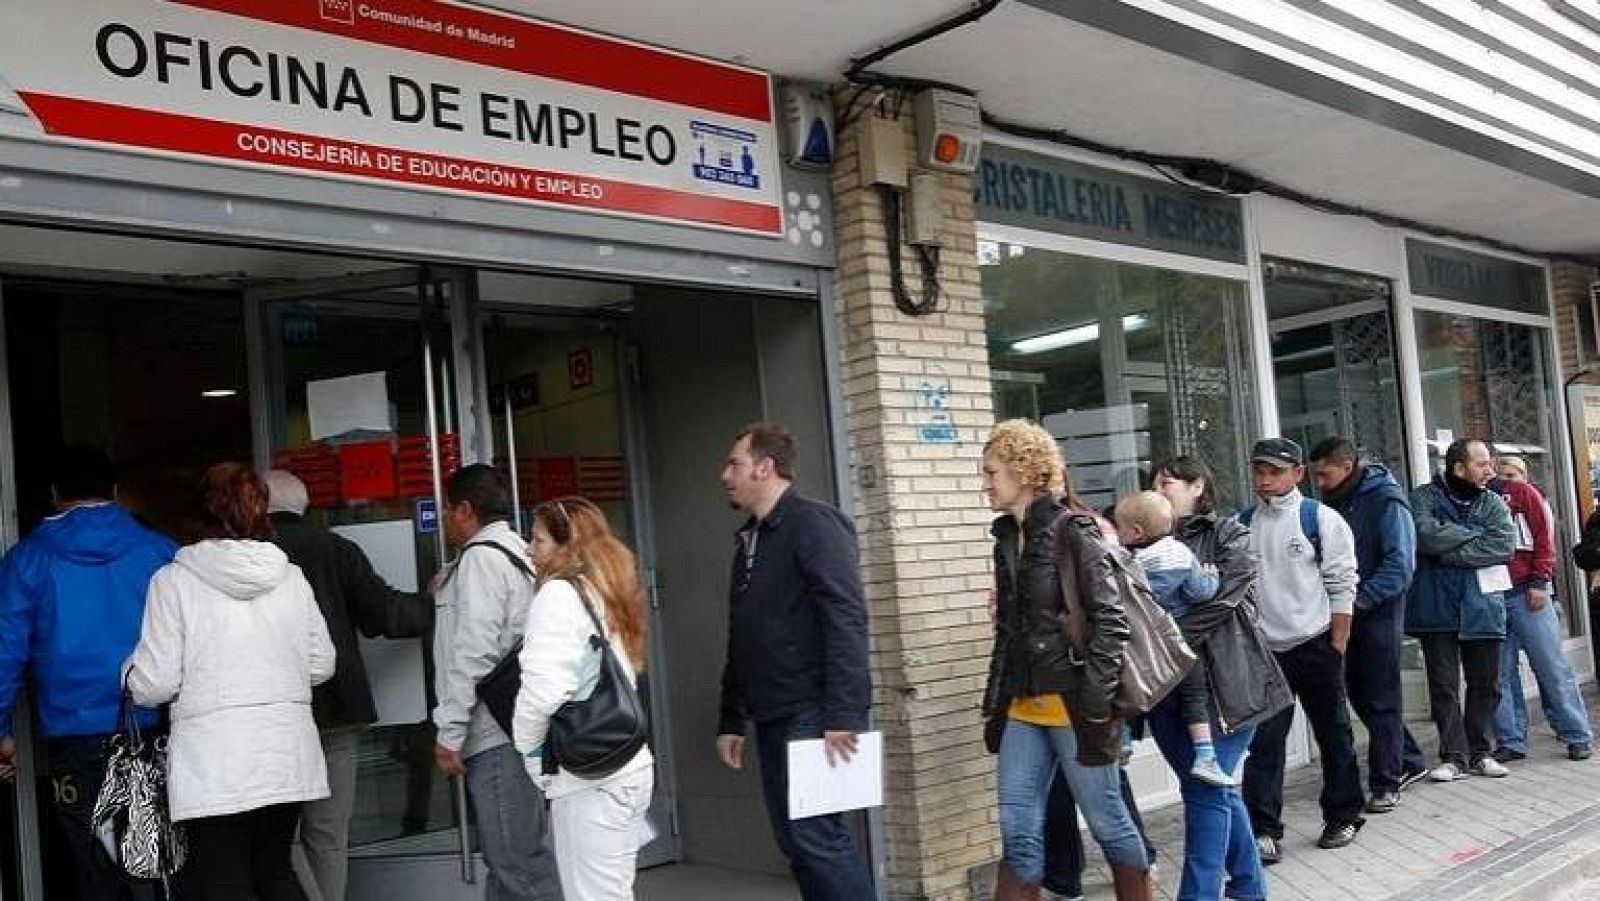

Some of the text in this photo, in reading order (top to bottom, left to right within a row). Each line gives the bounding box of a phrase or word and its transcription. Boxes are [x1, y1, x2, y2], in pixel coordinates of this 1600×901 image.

[358, 4, 516, 49] Comunidad de Madrid
[95, 23, 677, 166] OFICINA DE EMPLEO
[237, 132, 604, 200] CONSEJERÍA DE EDUCACIÓN Y EMPLEO
